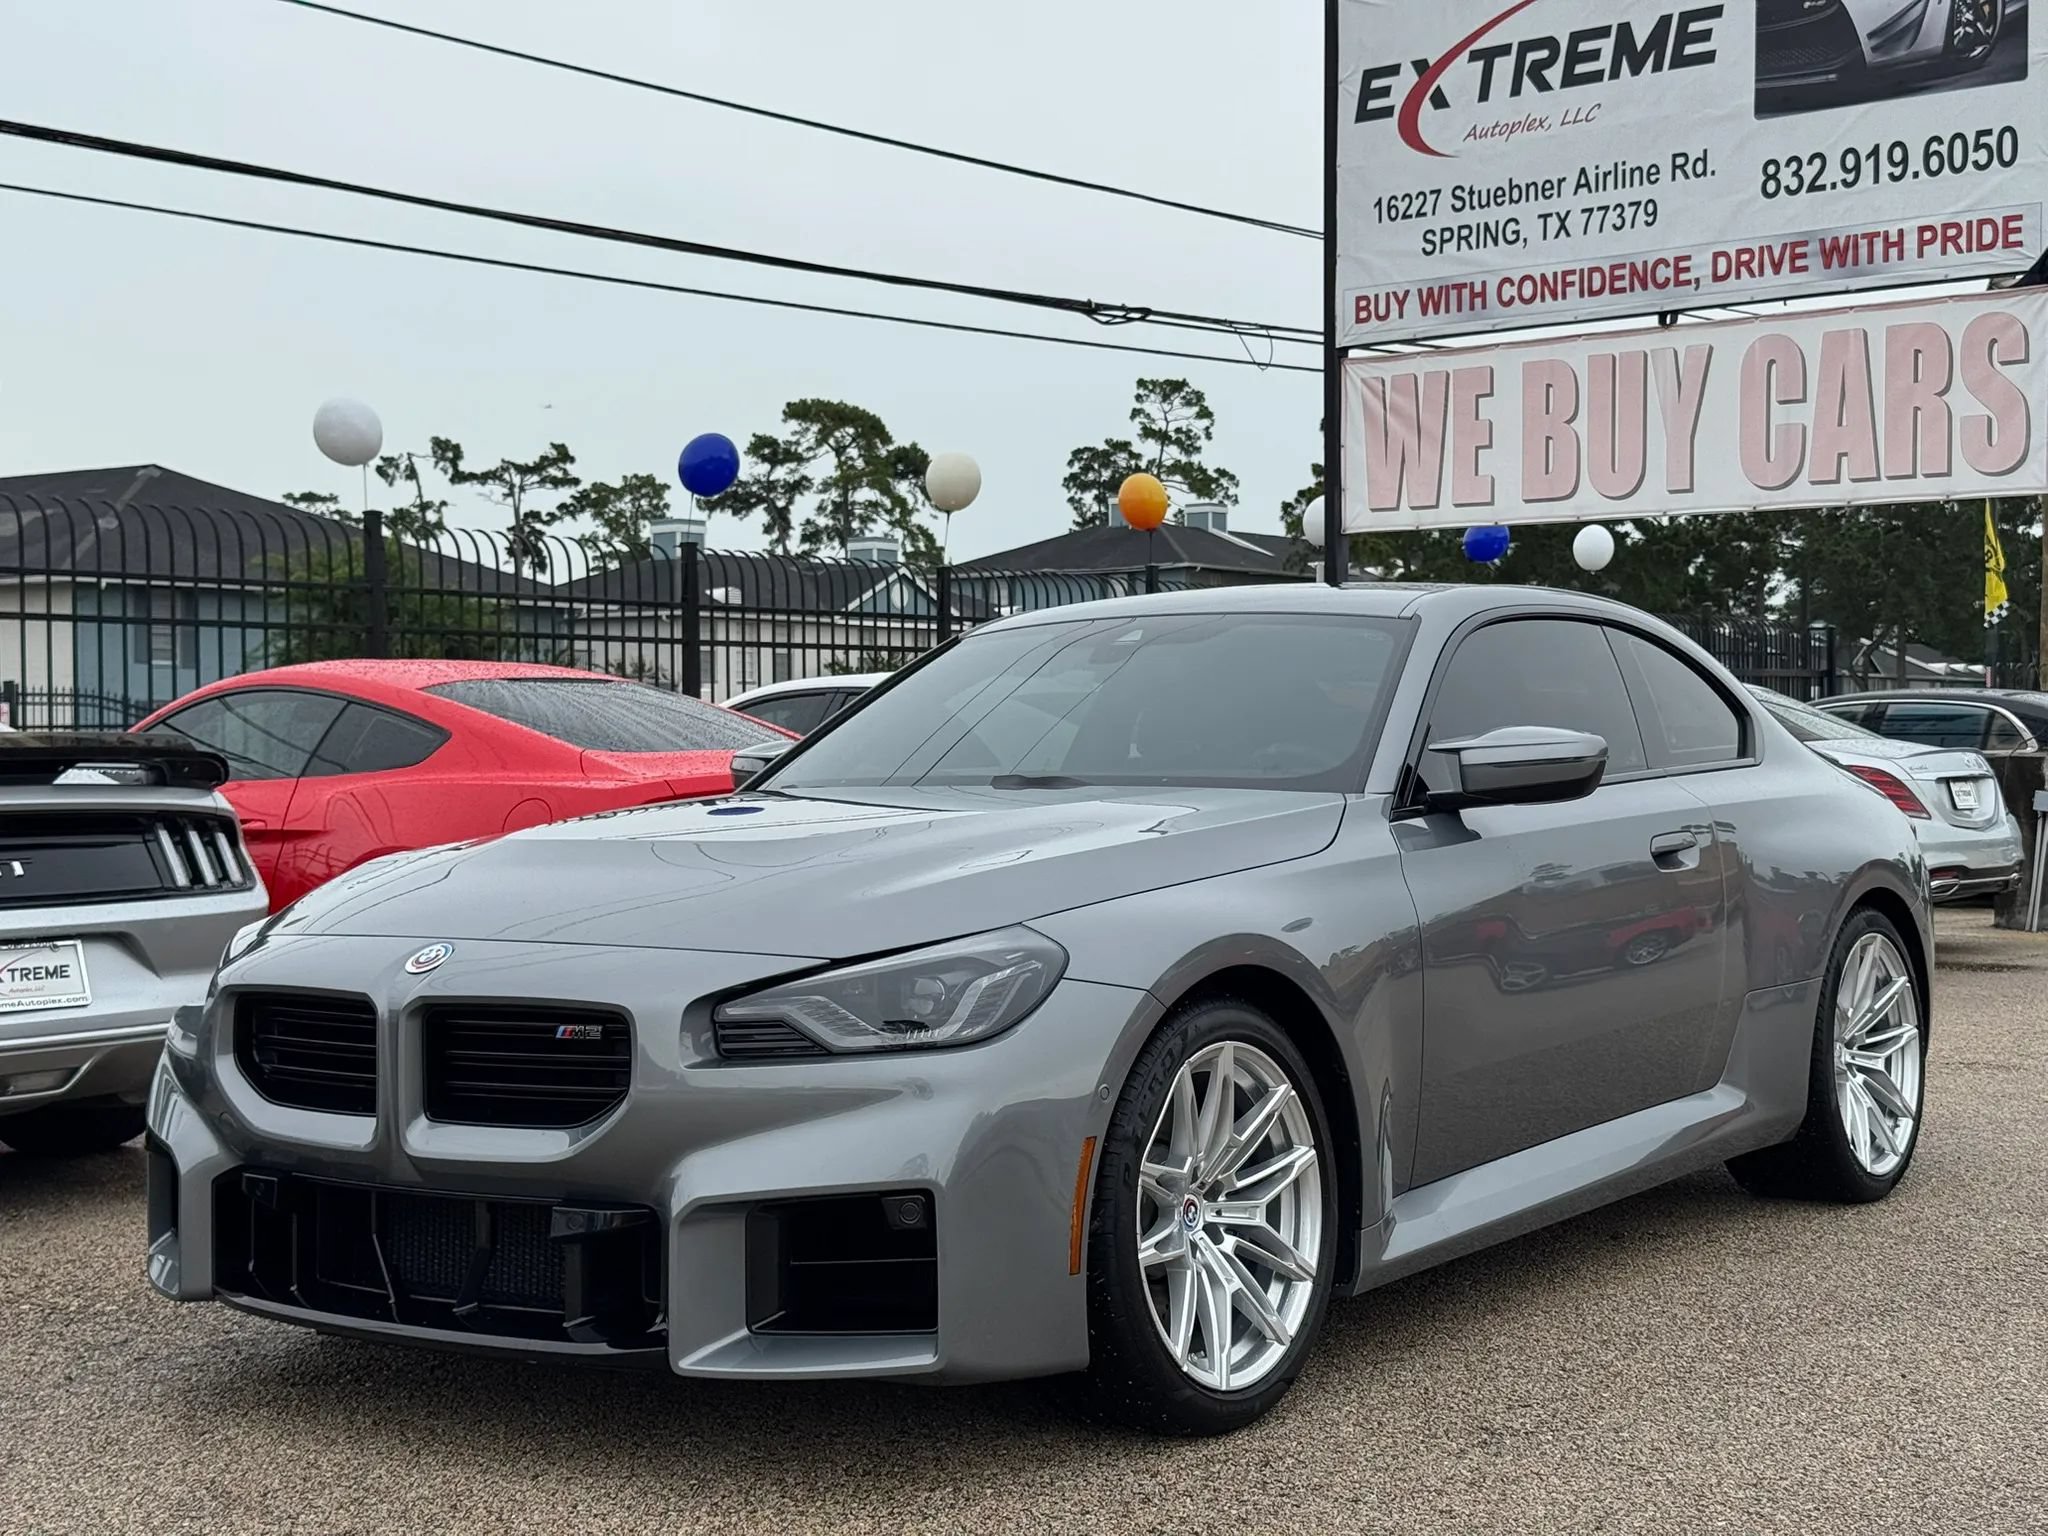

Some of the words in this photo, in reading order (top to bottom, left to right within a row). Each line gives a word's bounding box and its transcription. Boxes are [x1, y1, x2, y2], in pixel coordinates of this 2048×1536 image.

[1354, 4, 1725, 124] EXTREME
[1462, 112, 1552, 143] Autoplex,
[1560, 103, 1601, 127] LLC
[1373, 188, 1442, 224] 16227
[1451, 176, 1566, 213] Stuebner
[1573, 160, 1661, 197] Airline
[1671, 148, 1716, 182] Rd.
[1760, 125, 2018, 199] 832.919.6050
[1421, 218, 1528, 257] SPRING,
[1537, 210, 1572, 241] TX
[1580, 198, 1658, 236] 77379
[1354, 291, 1410, 324] BUY
[1417, 281, 1487, 316] WITH
[1496, 255, 1701, 308] CONFIDENCE,
[1711, 240, 1809, 283] DRIVE
[1818, 228, 1904, 270] WITH
[1916, 214, 2024, 259] PRIDE
[1361, 366, 1495, 512] WE
[1522, 343, 1714, 502] BUY
[1739, 311, 2031, 492] CARS
